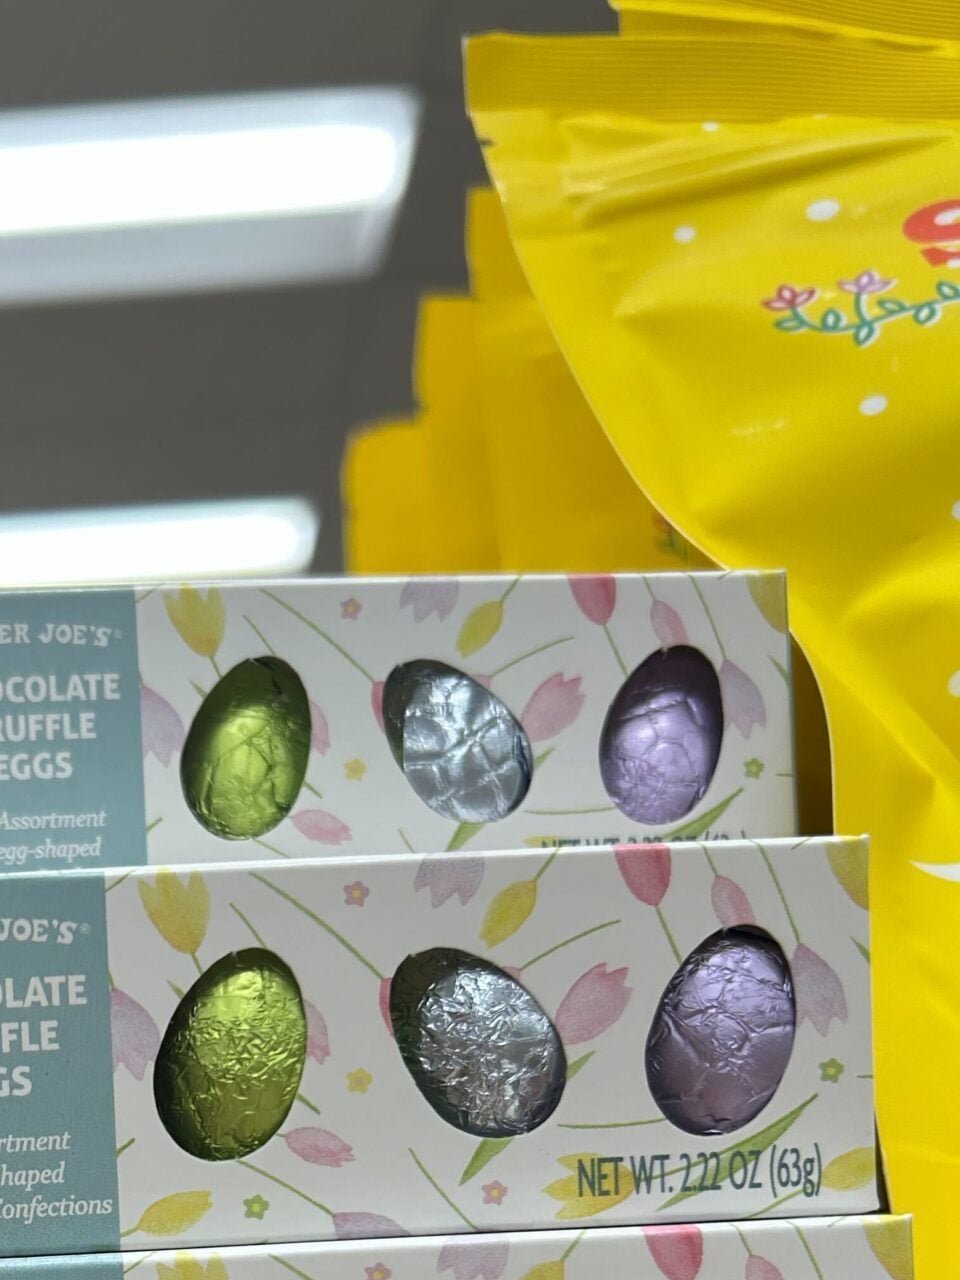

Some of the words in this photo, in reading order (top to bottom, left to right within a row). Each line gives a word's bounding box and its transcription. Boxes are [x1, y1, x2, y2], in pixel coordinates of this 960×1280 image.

[577, 1157, 624, 1197] NET
[630, 1154, 674, 1194] WT.
[679, 1152, 722, 1192] 2.22
[729, 1150, 762, 1189] OZ
[769, 1143, 822, 1198] (63g)
